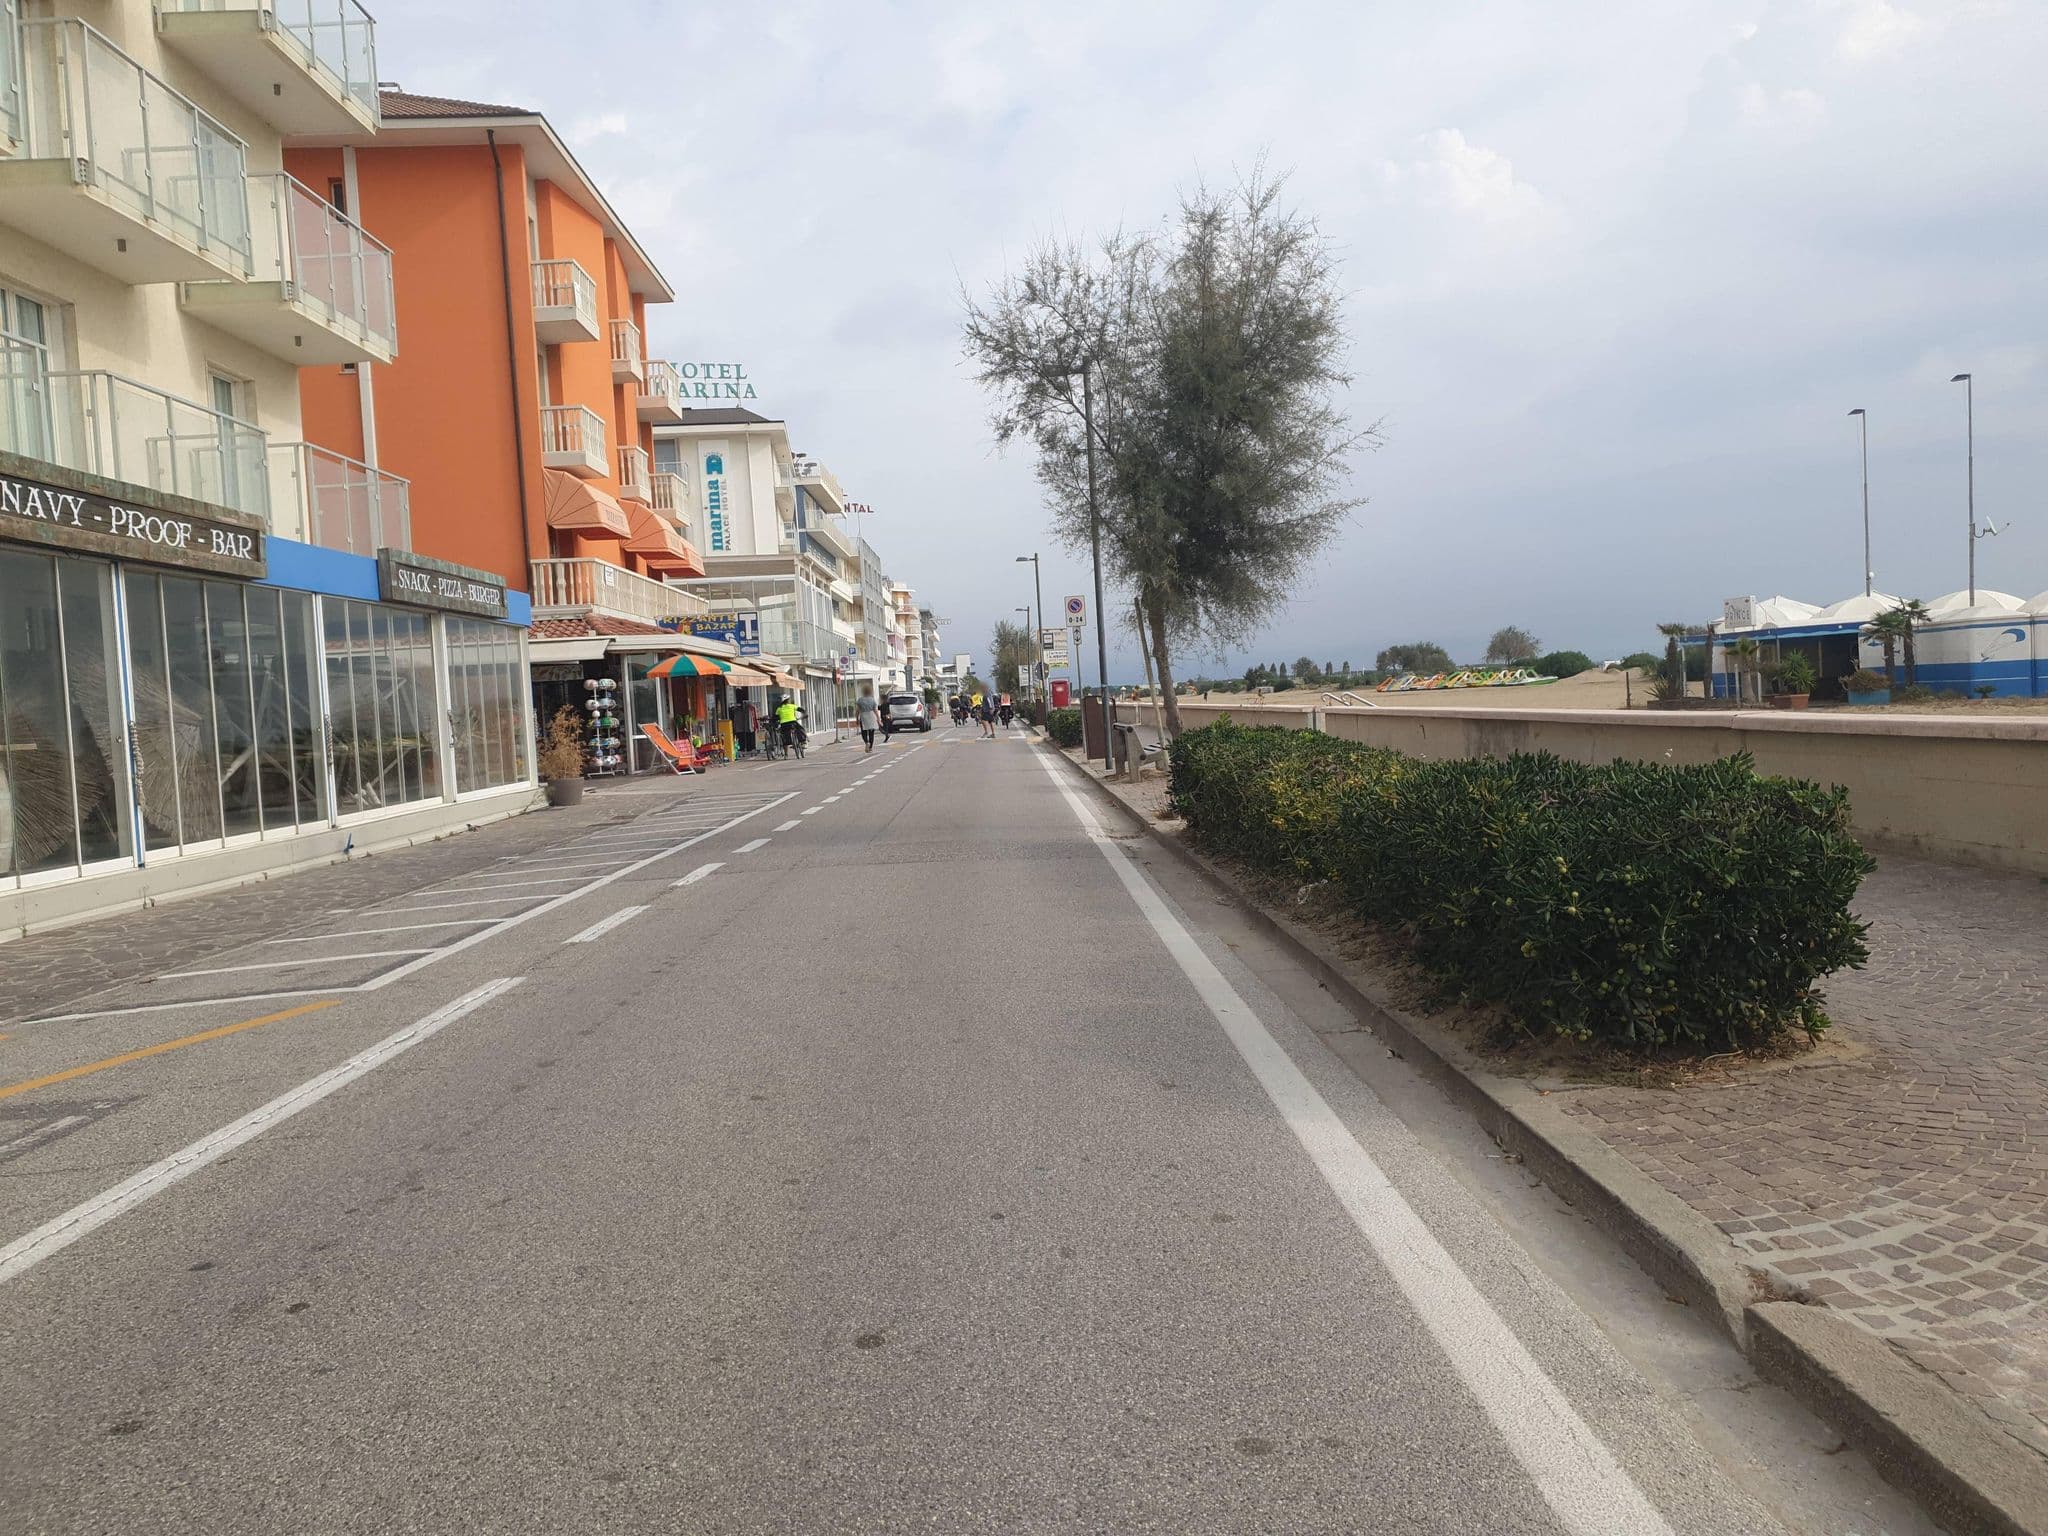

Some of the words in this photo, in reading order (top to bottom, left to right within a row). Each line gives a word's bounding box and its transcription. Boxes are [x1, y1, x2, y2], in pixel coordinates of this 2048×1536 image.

[0, 480, 87, 527] NAVY
[109, 505, 192, 548] PROOF
[210, 529, 252, 560] BAR
[704, 479, 724, 551] marina
[723, 514, 731, 551] PALACE
[398, 569, 431, 593] SNACK
[438, 578, 463, 599] PIZZA
[468, 584, 500, 606] BURGER
[663, 613, 736, 624] RIZZANTE
[696, 622, 737, 631] BAZAR
